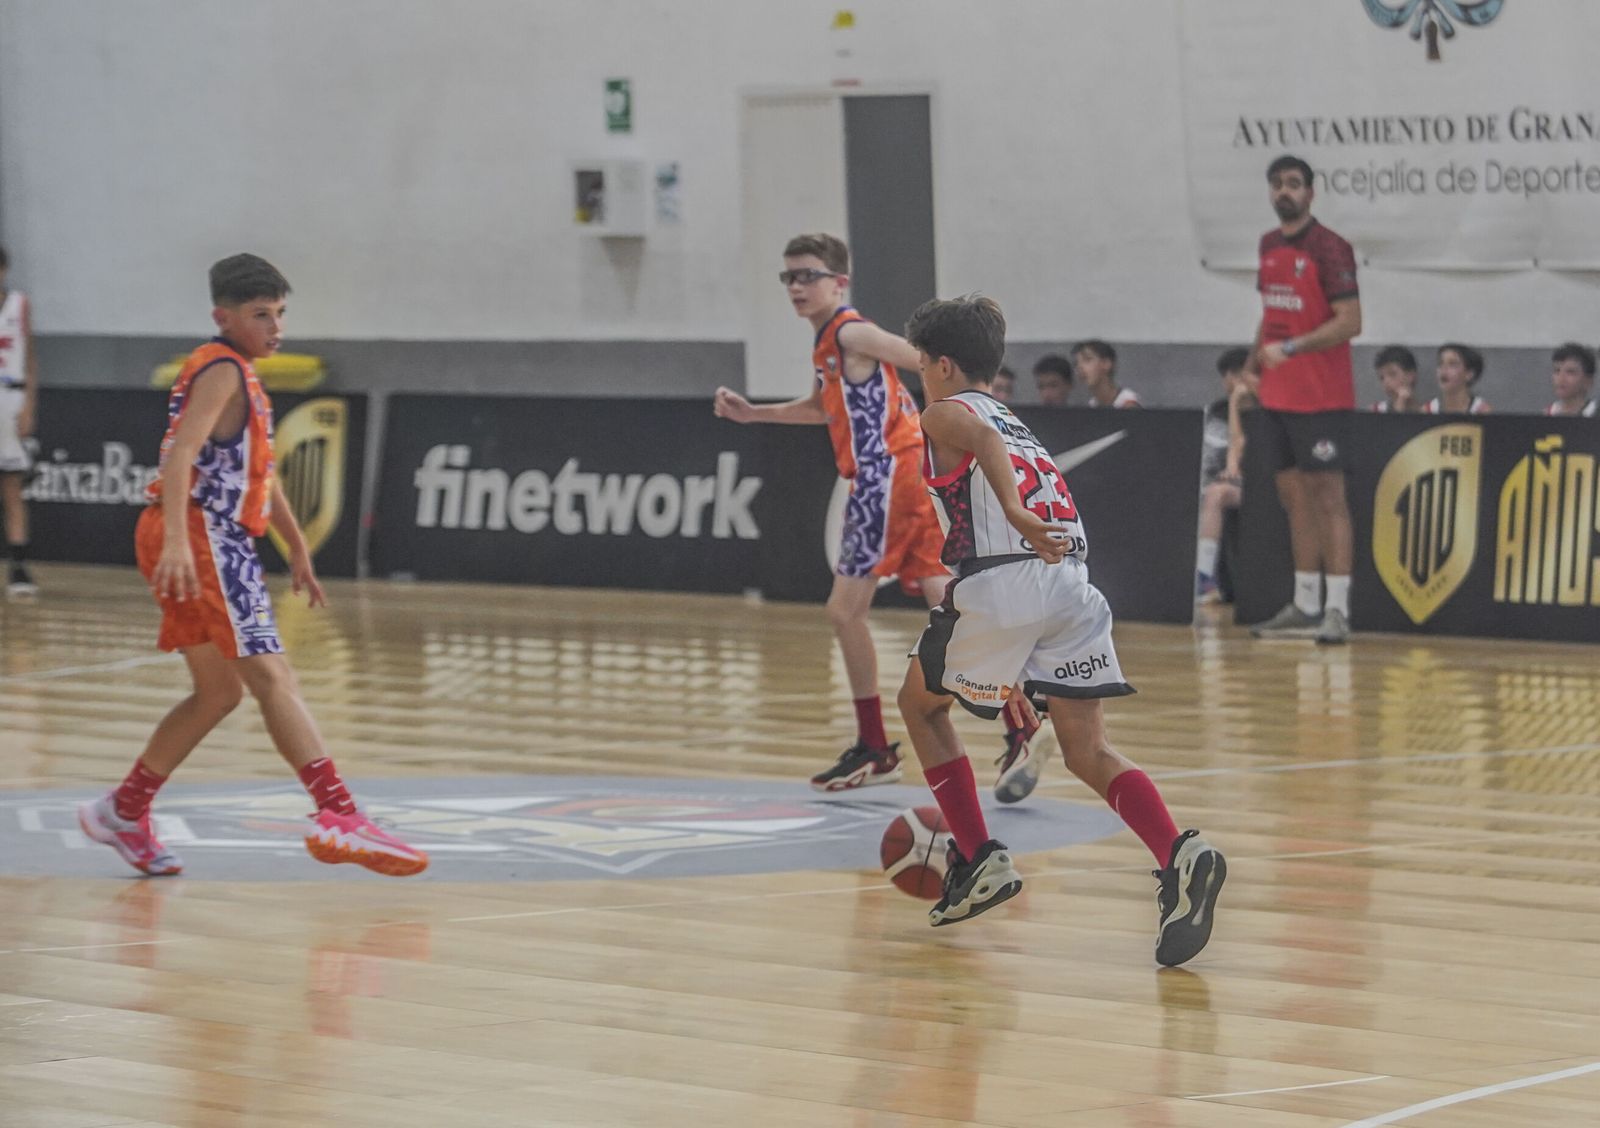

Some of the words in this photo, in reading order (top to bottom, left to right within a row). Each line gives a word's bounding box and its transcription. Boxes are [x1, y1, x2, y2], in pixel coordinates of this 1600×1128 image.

[1233, 115, 1455, 147] AYUNTAMIENTO
[1466, 114, 1499, 142] DE
[1508, 104, 1600, 143] GRAN
[1312, 160, 1425, 201] ncejalía
[1436, 161, 1476, 194] de
[1440, 435, 1473, 457] FEB
[22, 437, 159, 505] aixaBa
[414, 443, 762, 540] finetwork
[1008, 453, 1079, 523] 23
[1395, 468, 1457, 586] 100
[1494, 435, 1600, 604] AÑO
[954, 673, 999, 692] Granada
[1054, 653, 1110, 680] alight
[961, 686, 997, 701] Digital
